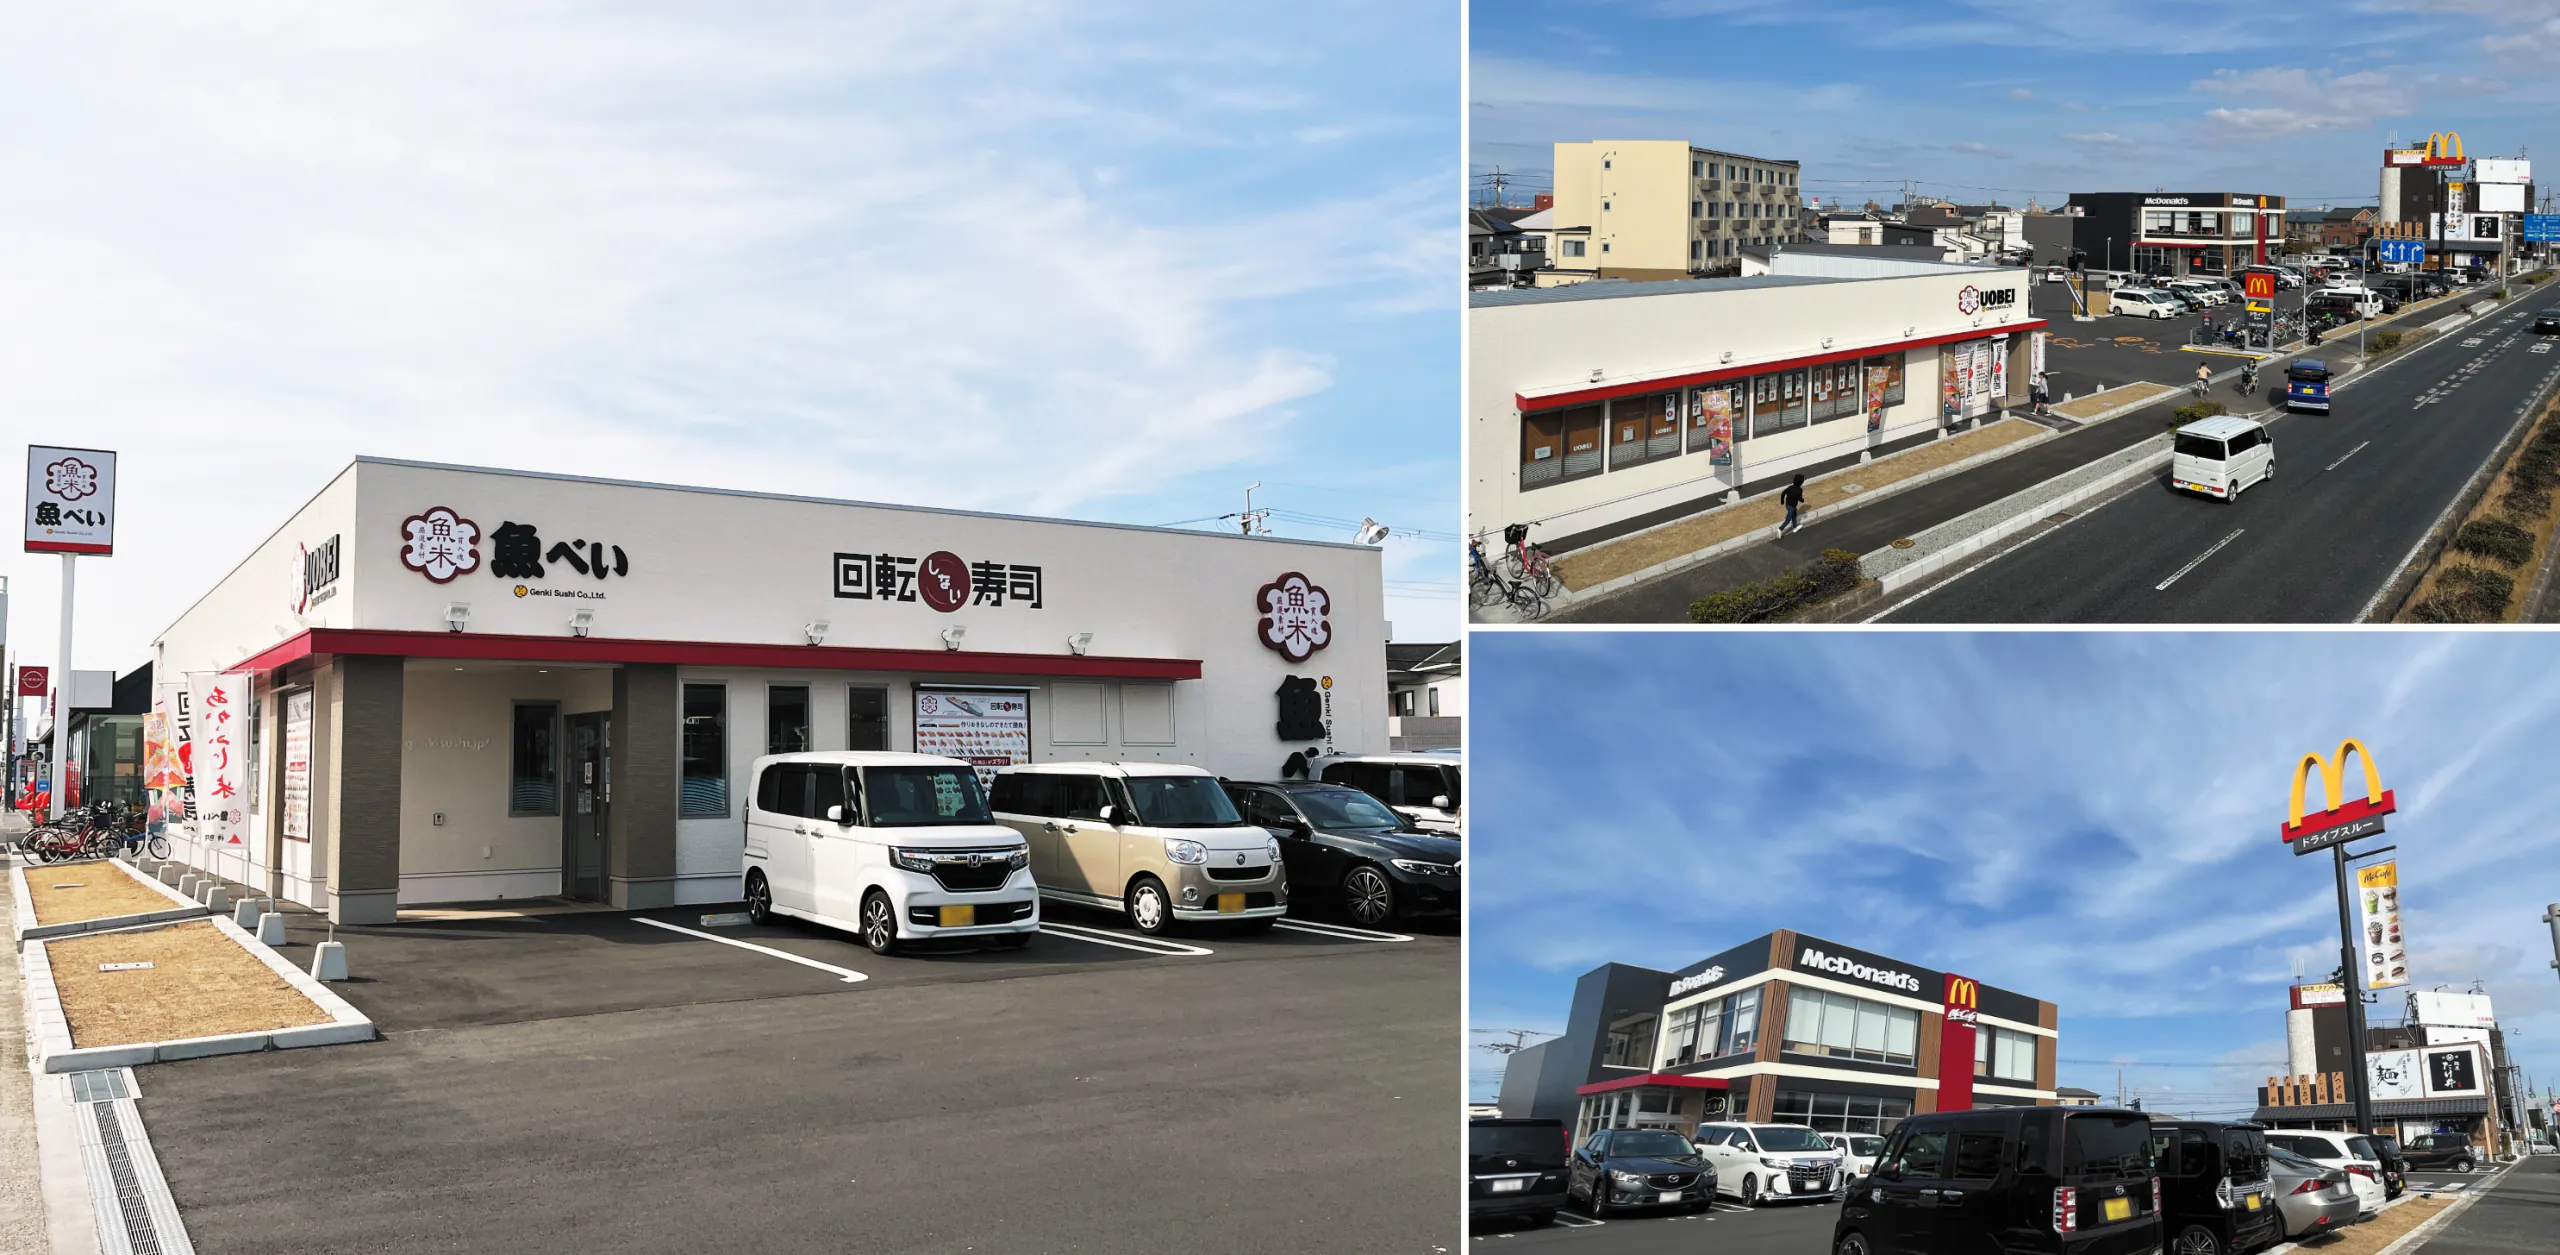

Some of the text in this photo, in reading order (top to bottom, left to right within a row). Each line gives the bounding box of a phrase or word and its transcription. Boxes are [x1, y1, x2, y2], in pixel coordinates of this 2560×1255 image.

[2144, 197, 2189, 205] McDonald's
[1980, 288, 2015, 306] UOBEI
[35, 501, 106, 526] 魚べい
[425, 517, 457, 569] 魚米
[490, 520, 629, 580] 魚べい
[306, 533, 340, 595] UOBEI
[530, 587, 606, 600] Genki Sushi Co.,Ltd.
[1284, 585, 1312, 645] 魚米
[1324, 691, 1332, 717] Genki
[1325, 719, 1334, 744] Sushi
[2301, 820, 2374, 849] ドライブスルー
[1800, 948, 1920, 992] McDonald's
[2376, 1064, 2400, 1087] 麺
